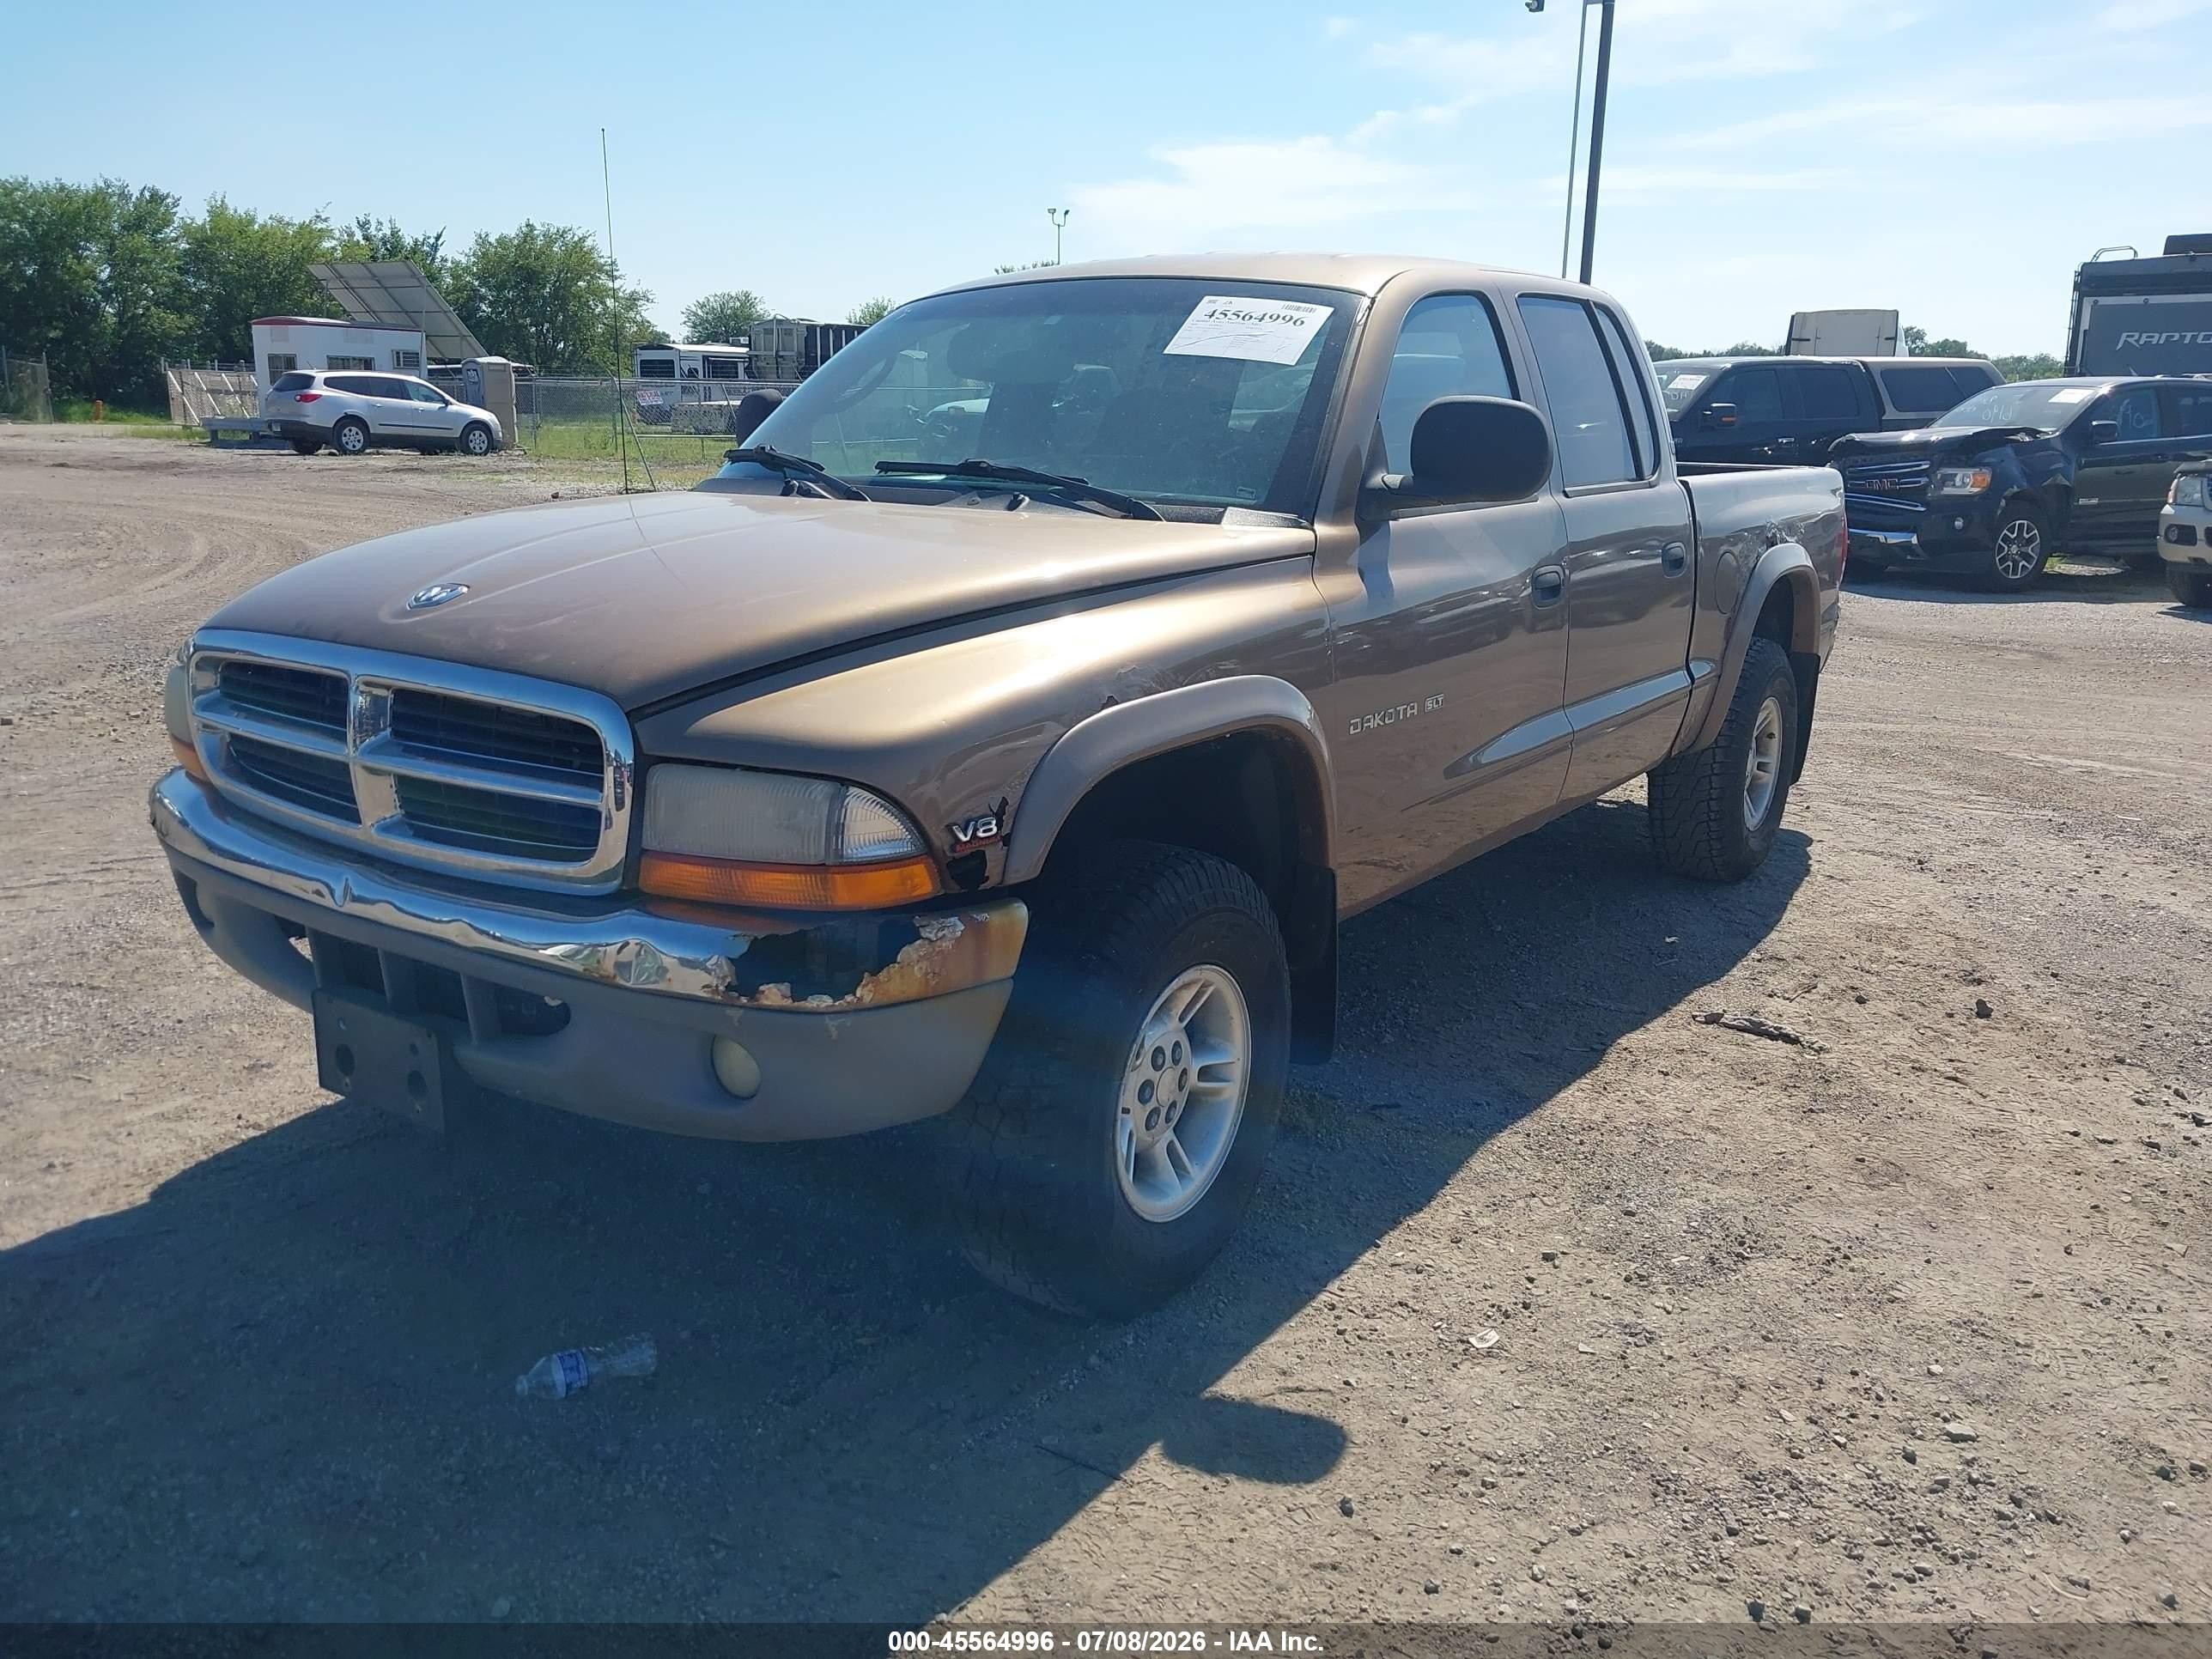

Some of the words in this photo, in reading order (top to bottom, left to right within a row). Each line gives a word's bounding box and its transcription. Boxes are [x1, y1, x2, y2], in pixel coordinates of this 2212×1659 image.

[1204, 307, 1306, 327] 45564996
[1866, 478, 1899, 490] GMC
[1349, 702, 1418, 734] DAKOTA
[1425, 695, 1444, 713] SLT
[951, 817, 997, 842] V8
